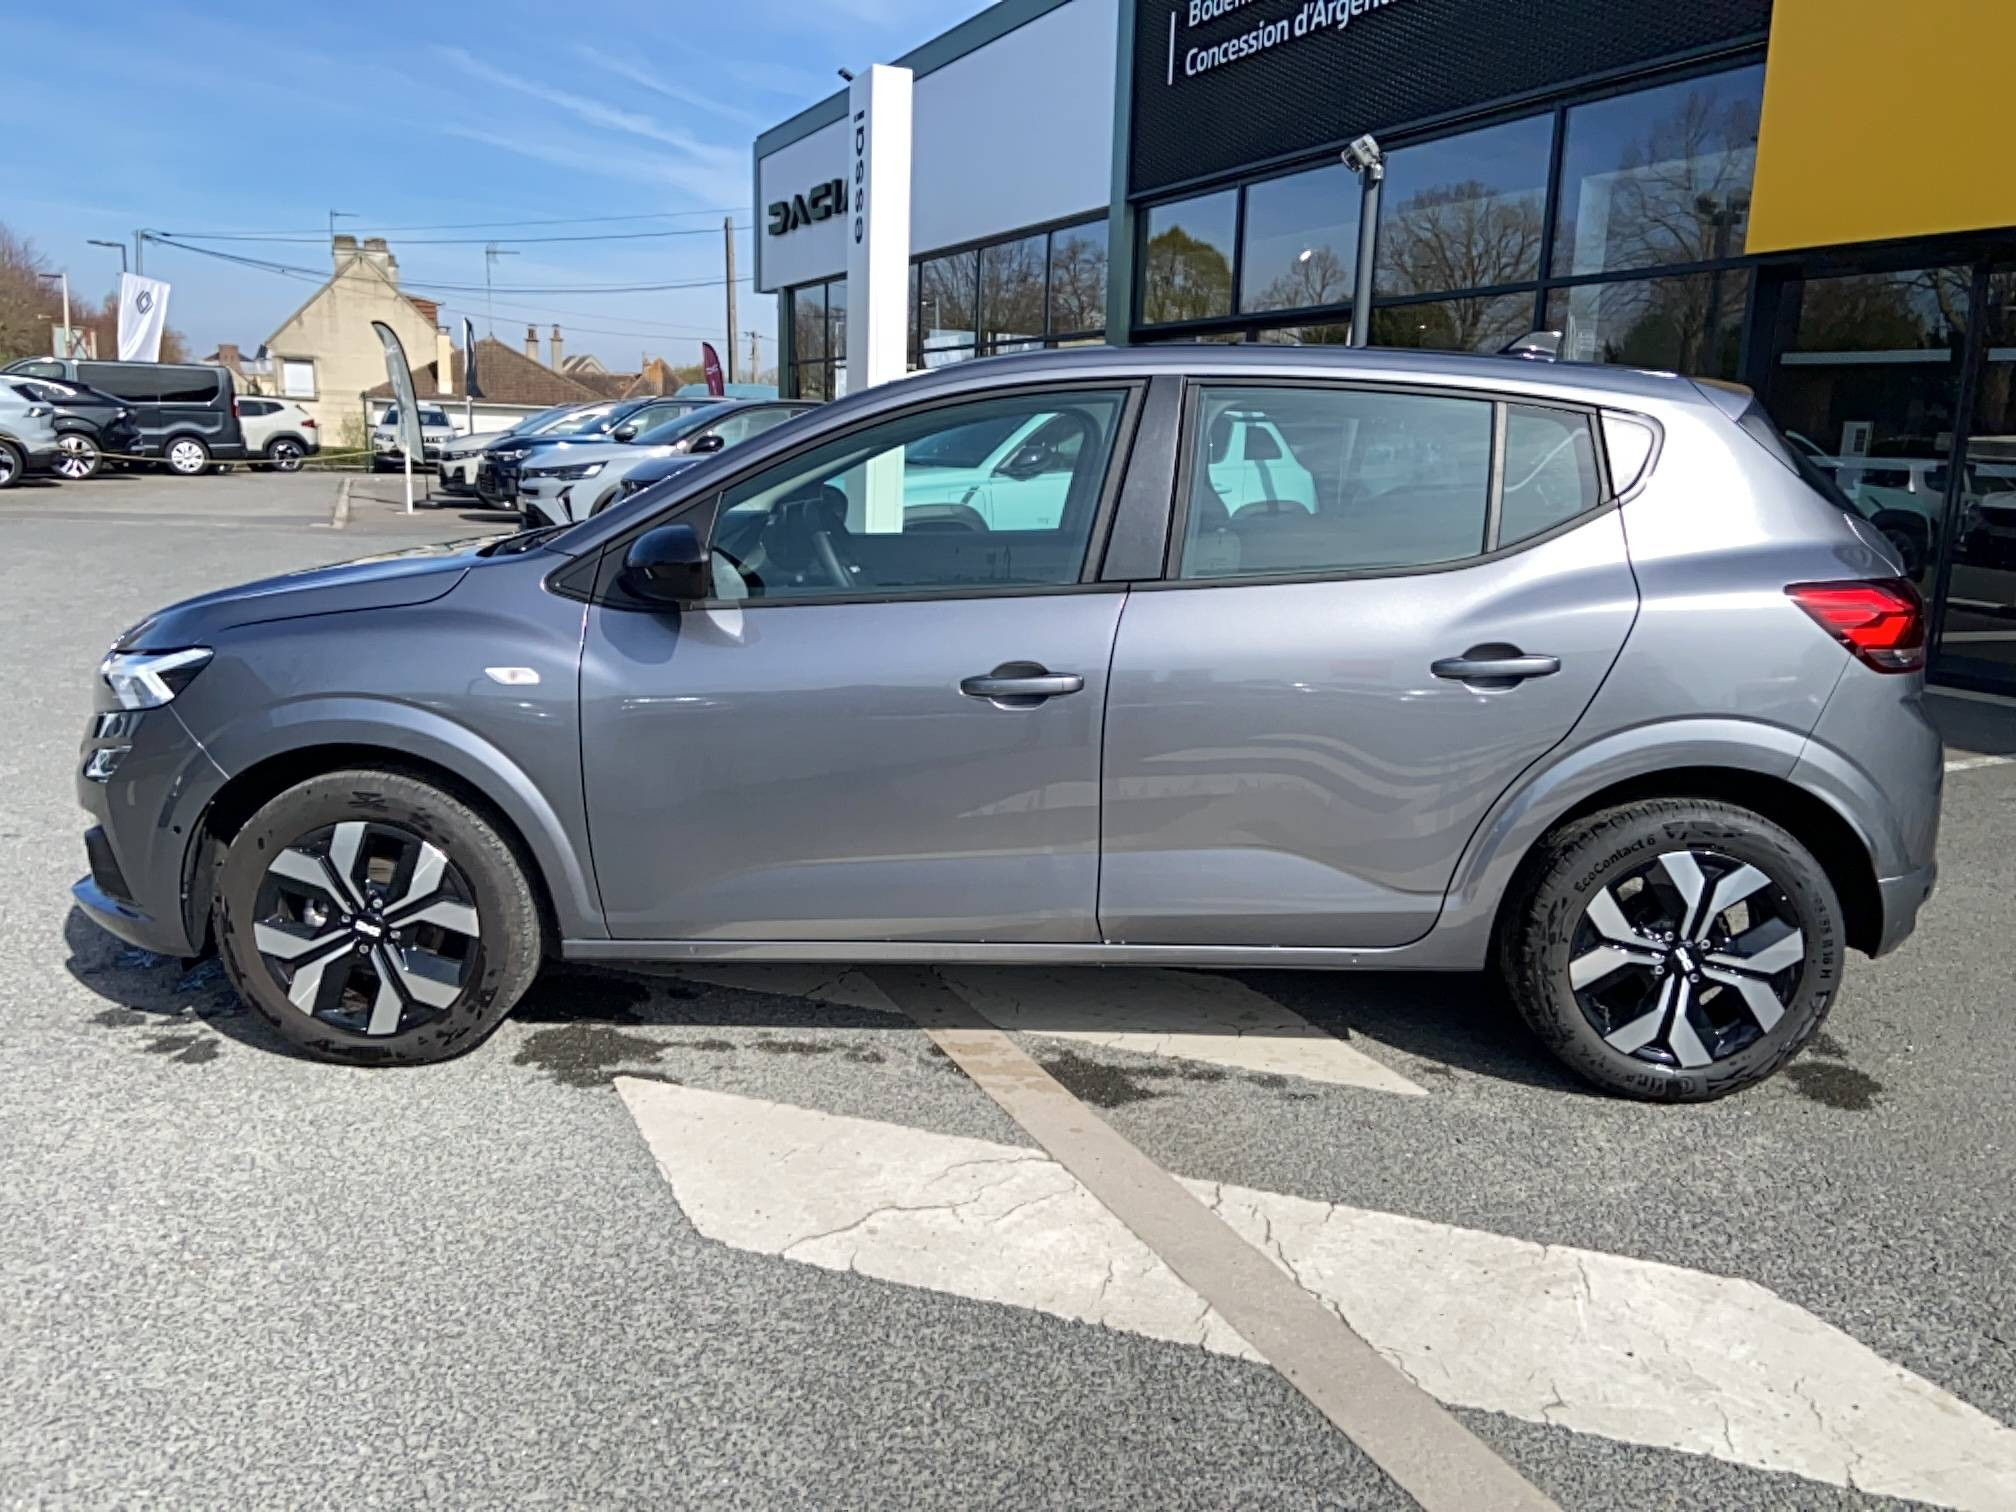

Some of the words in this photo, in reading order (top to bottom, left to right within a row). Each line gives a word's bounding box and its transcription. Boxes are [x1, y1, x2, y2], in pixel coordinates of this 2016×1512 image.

[1185, 20, 1289, 77] Concession
[1294, 0, 1391, 37] d'Arge
[768, 178, 849, 236] DACI
[854, 110, 865, 244] essai
[1574, 839, 1645, 893] EcoContact
